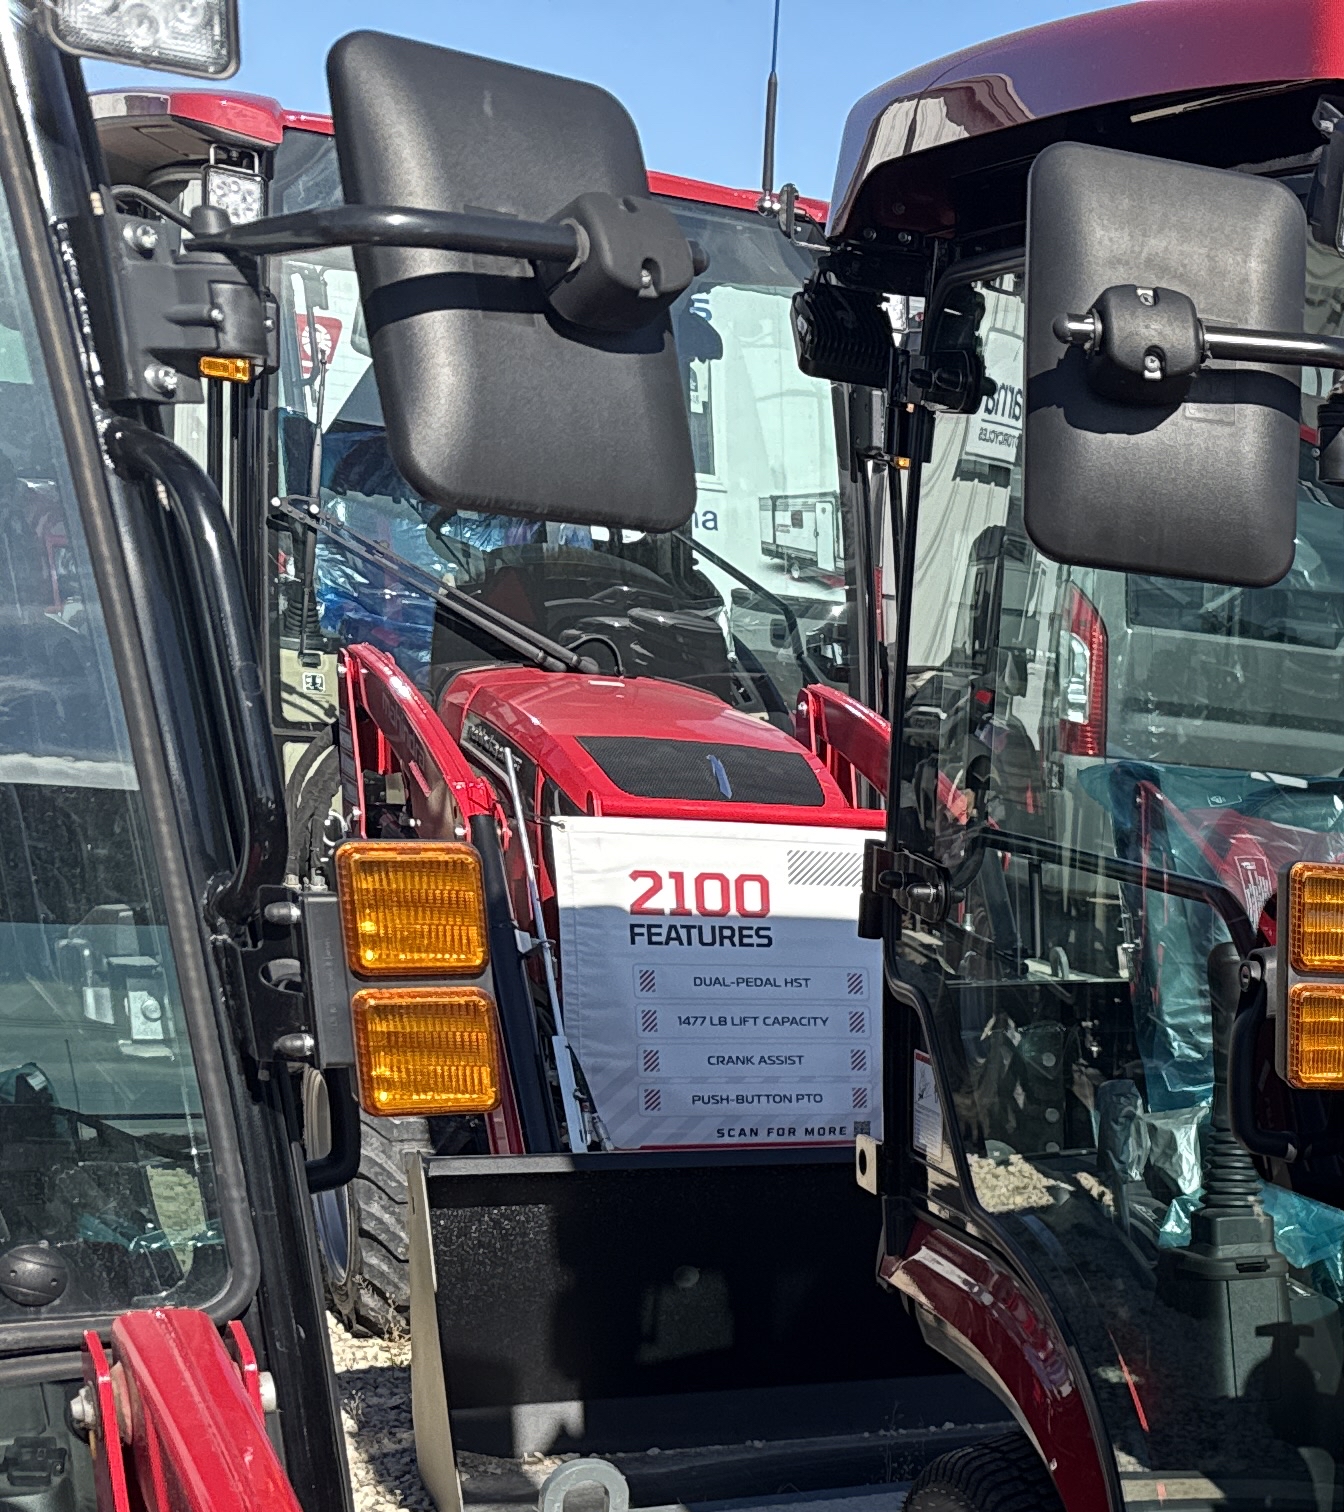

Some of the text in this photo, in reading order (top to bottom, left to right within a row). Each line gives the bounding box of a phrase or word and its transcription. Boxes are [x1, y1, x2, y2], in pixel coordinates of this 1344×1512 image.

[629, 870, 770, 918] 2100
[629, 923, 773, 948] FEATURES
[693, 976, 811, 988] DUAL-PEDAL HST
[677, 1015, 829, 1027] 1477 LB LIFT CAPACITY
[707, 1055, 804, 1066] CRANK ASSIST
[692, 1093, 823, 1105] PUSH-BUTTON PTO
[716, 1126, 848, 1138] SCAN FOR MORE
